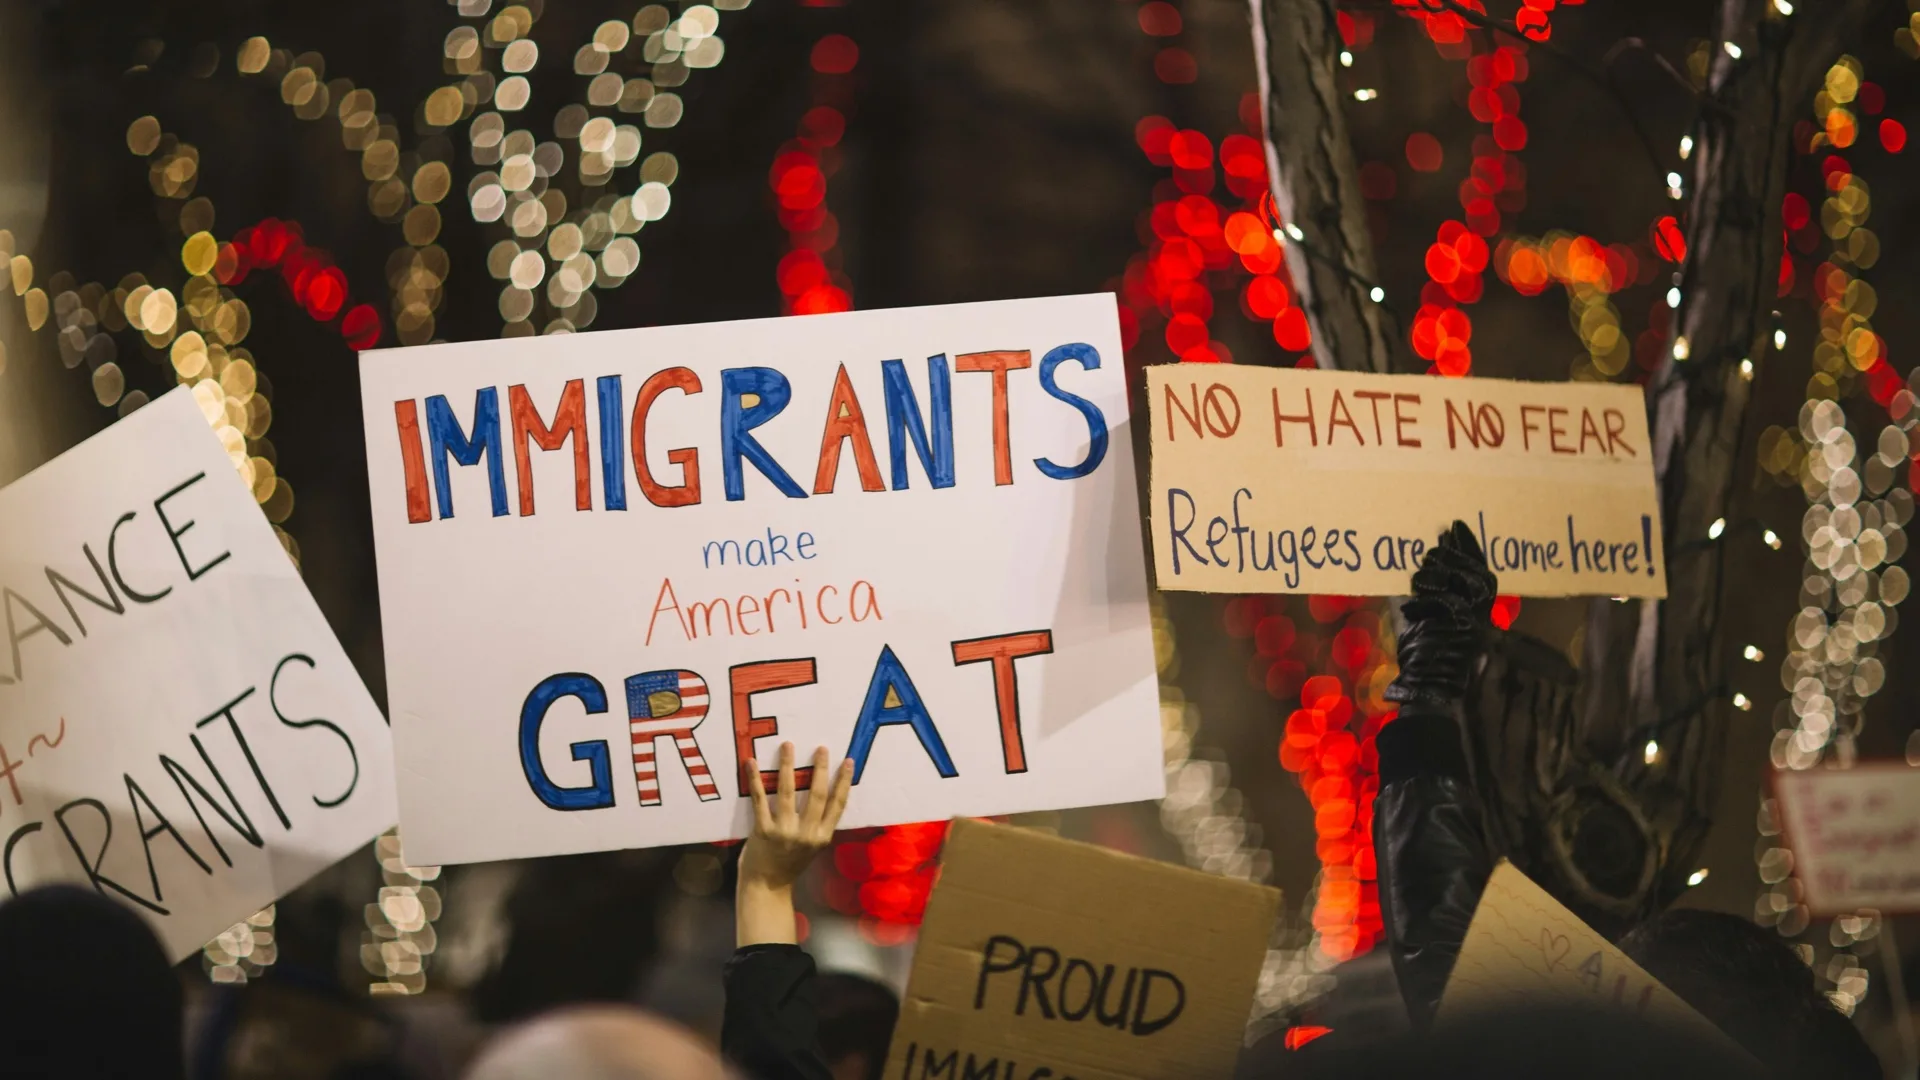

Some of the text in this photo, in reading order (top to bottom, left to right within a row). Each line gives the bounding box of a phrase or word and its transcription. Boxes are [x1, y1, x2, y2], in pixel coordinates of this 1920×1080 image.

[394, 342, 1109, 524] IMMIGRANTS
[1271, 388, 1422, 449] HATE
[1520, 404, 1636, 457] FEAR
[0, 470, 232, 684] ANCE
[702, 527, 817, 568] make
[1167, 488, 1656, 588] Refugees are lcome here!
[645, 577, 882, 647] America
[518, 629, 1054, 811] GREAT
[973, 935, 1186, 1037] PROUD
